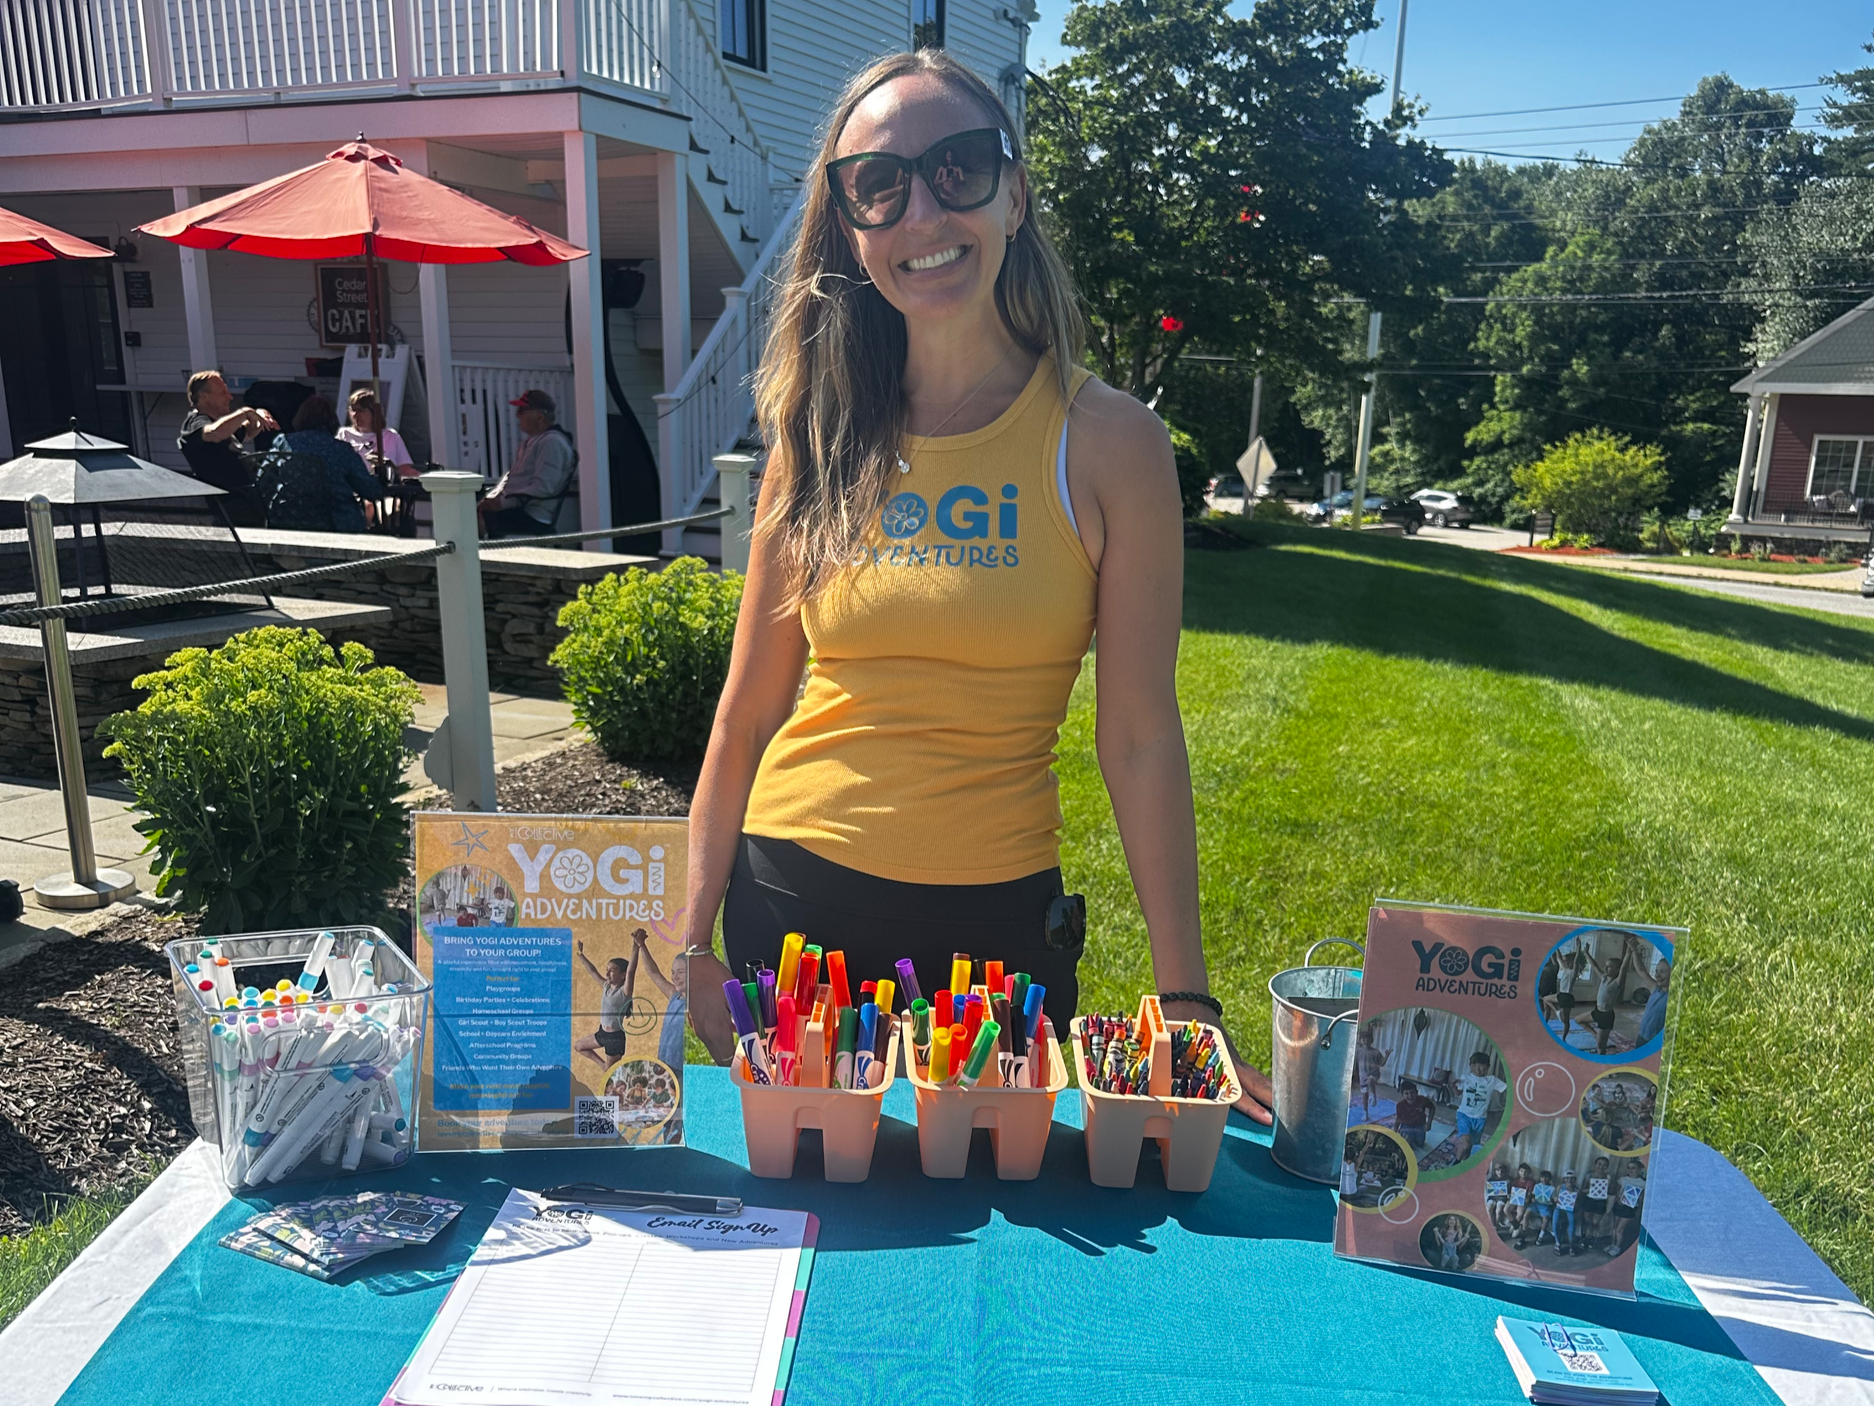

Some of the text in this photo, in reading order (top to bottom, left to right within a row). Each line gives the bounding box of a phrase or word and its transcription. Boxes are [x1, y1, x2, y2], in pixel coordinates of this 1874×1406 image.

[335, 278, 367, 291] Cedar
[336, 291, 369, 303] Street
[881, 483, 1018, 540] OGi
[852, 545, 1019, 569] DVENTURES
[521, 897, 665, 921] ADVENTURES
[444, 936, 562, 946] BRING YOGI ADVENTURES
[465, 948, 542, 958] TO YOUR GROUP!
[1415, 976, 1518, 1000] ADVENTURES
[494, 1019, 506, 1027] Boy
[527, 1019, 548, 1027] Troops
[646, 1216, 705, 1230] Email
